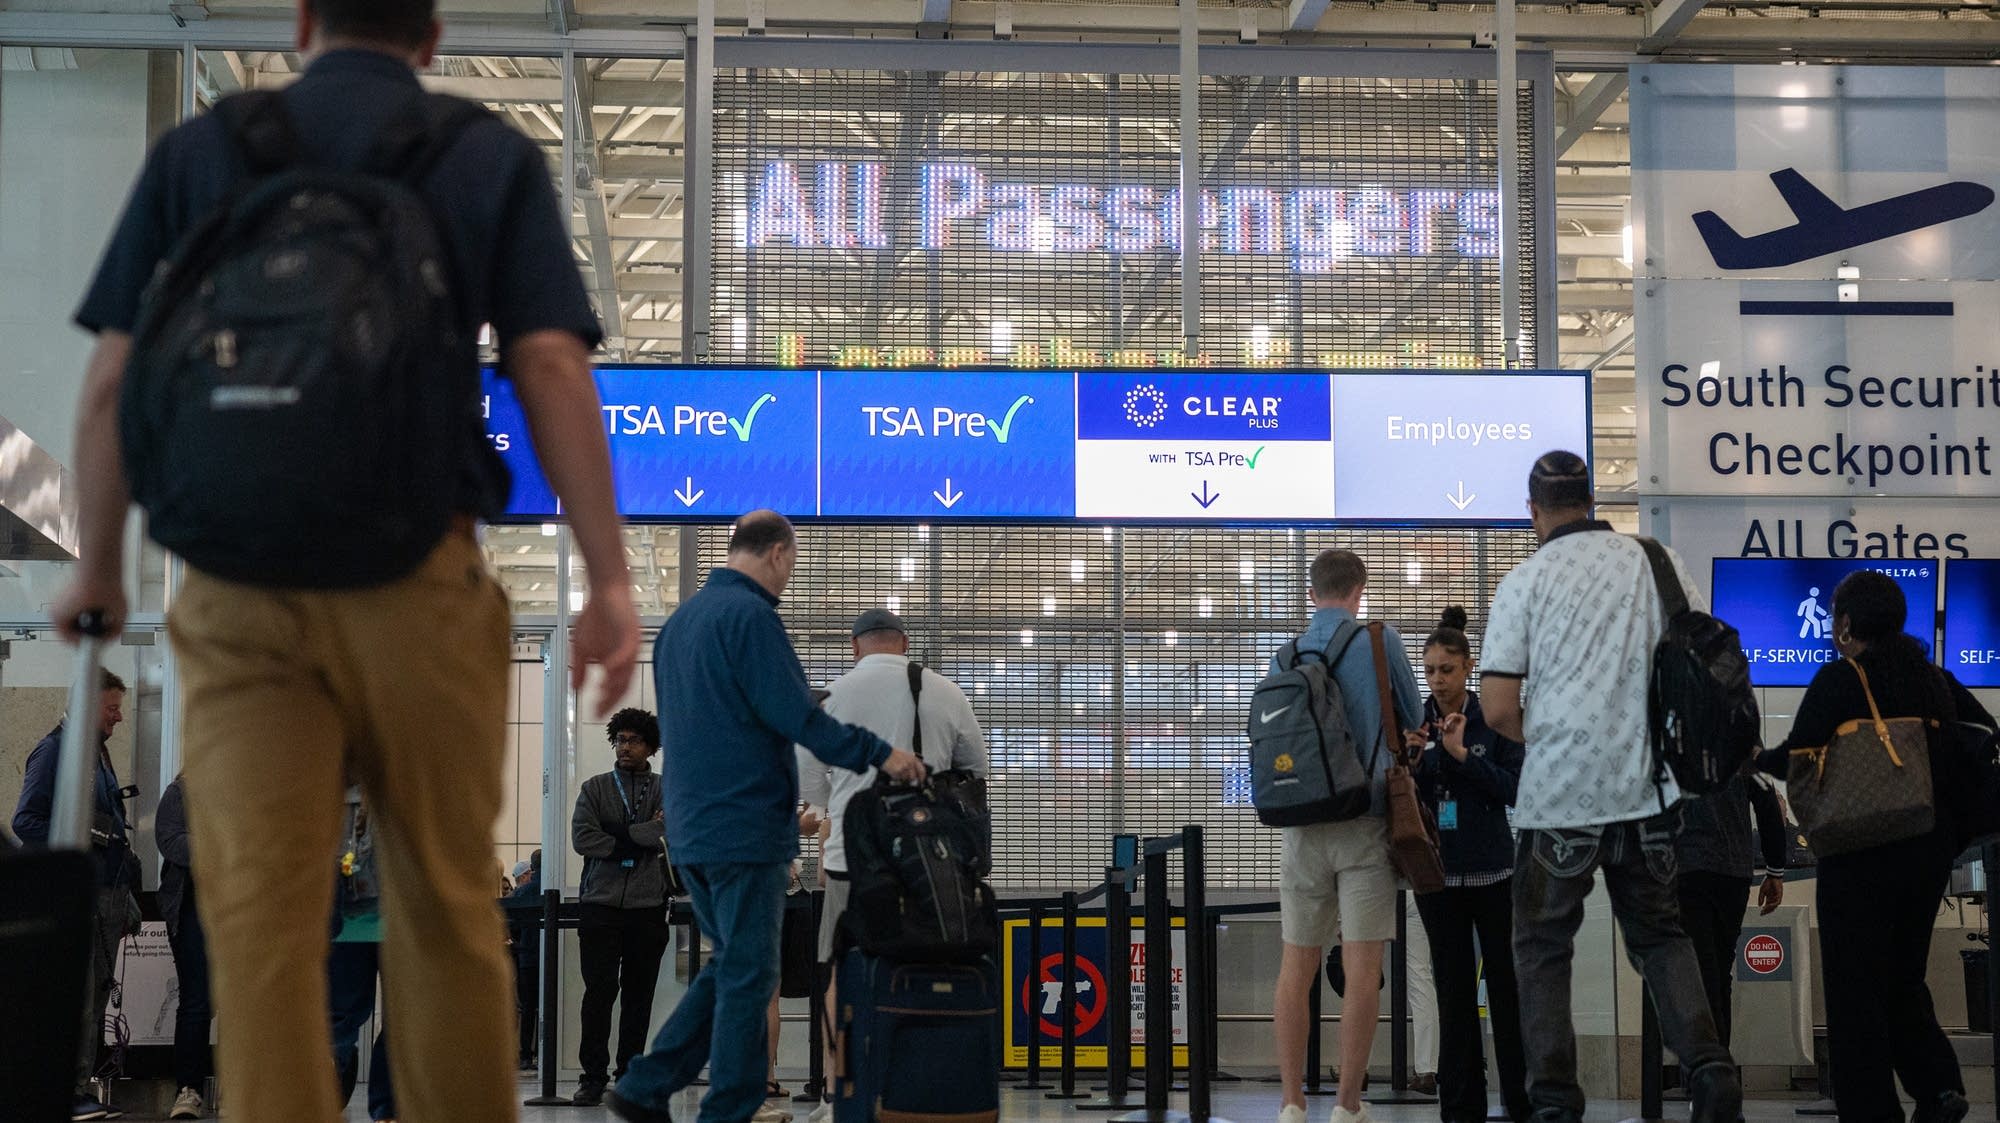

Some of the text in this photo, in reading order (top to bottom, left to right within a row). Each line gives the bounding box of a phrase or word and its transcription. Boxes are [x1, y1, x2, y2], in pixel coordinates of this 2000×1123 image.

[751, 161, 1502, 272] All Passengers
[1661, 363, 1805, 407] South
[602, 405, 665, 435] TSA
[1183, 396, 1278, 416] CLEAR
[862, 406, 924, 437] TSA
[1249, 418, 1279, 429] PLUS
[1387, 415, 1532, 445] Employees
[1149, 454, 1176, 463] WITH
[1185, 451, 1215, 466] TSA
[1709, 432, 1991, 487] Checkpoint
[1741, 519, 1969, 559] All Gates
[1741, 649, 1833, 663] LF-SERVICE
[1752, 958, 1777, 966] ENTER
